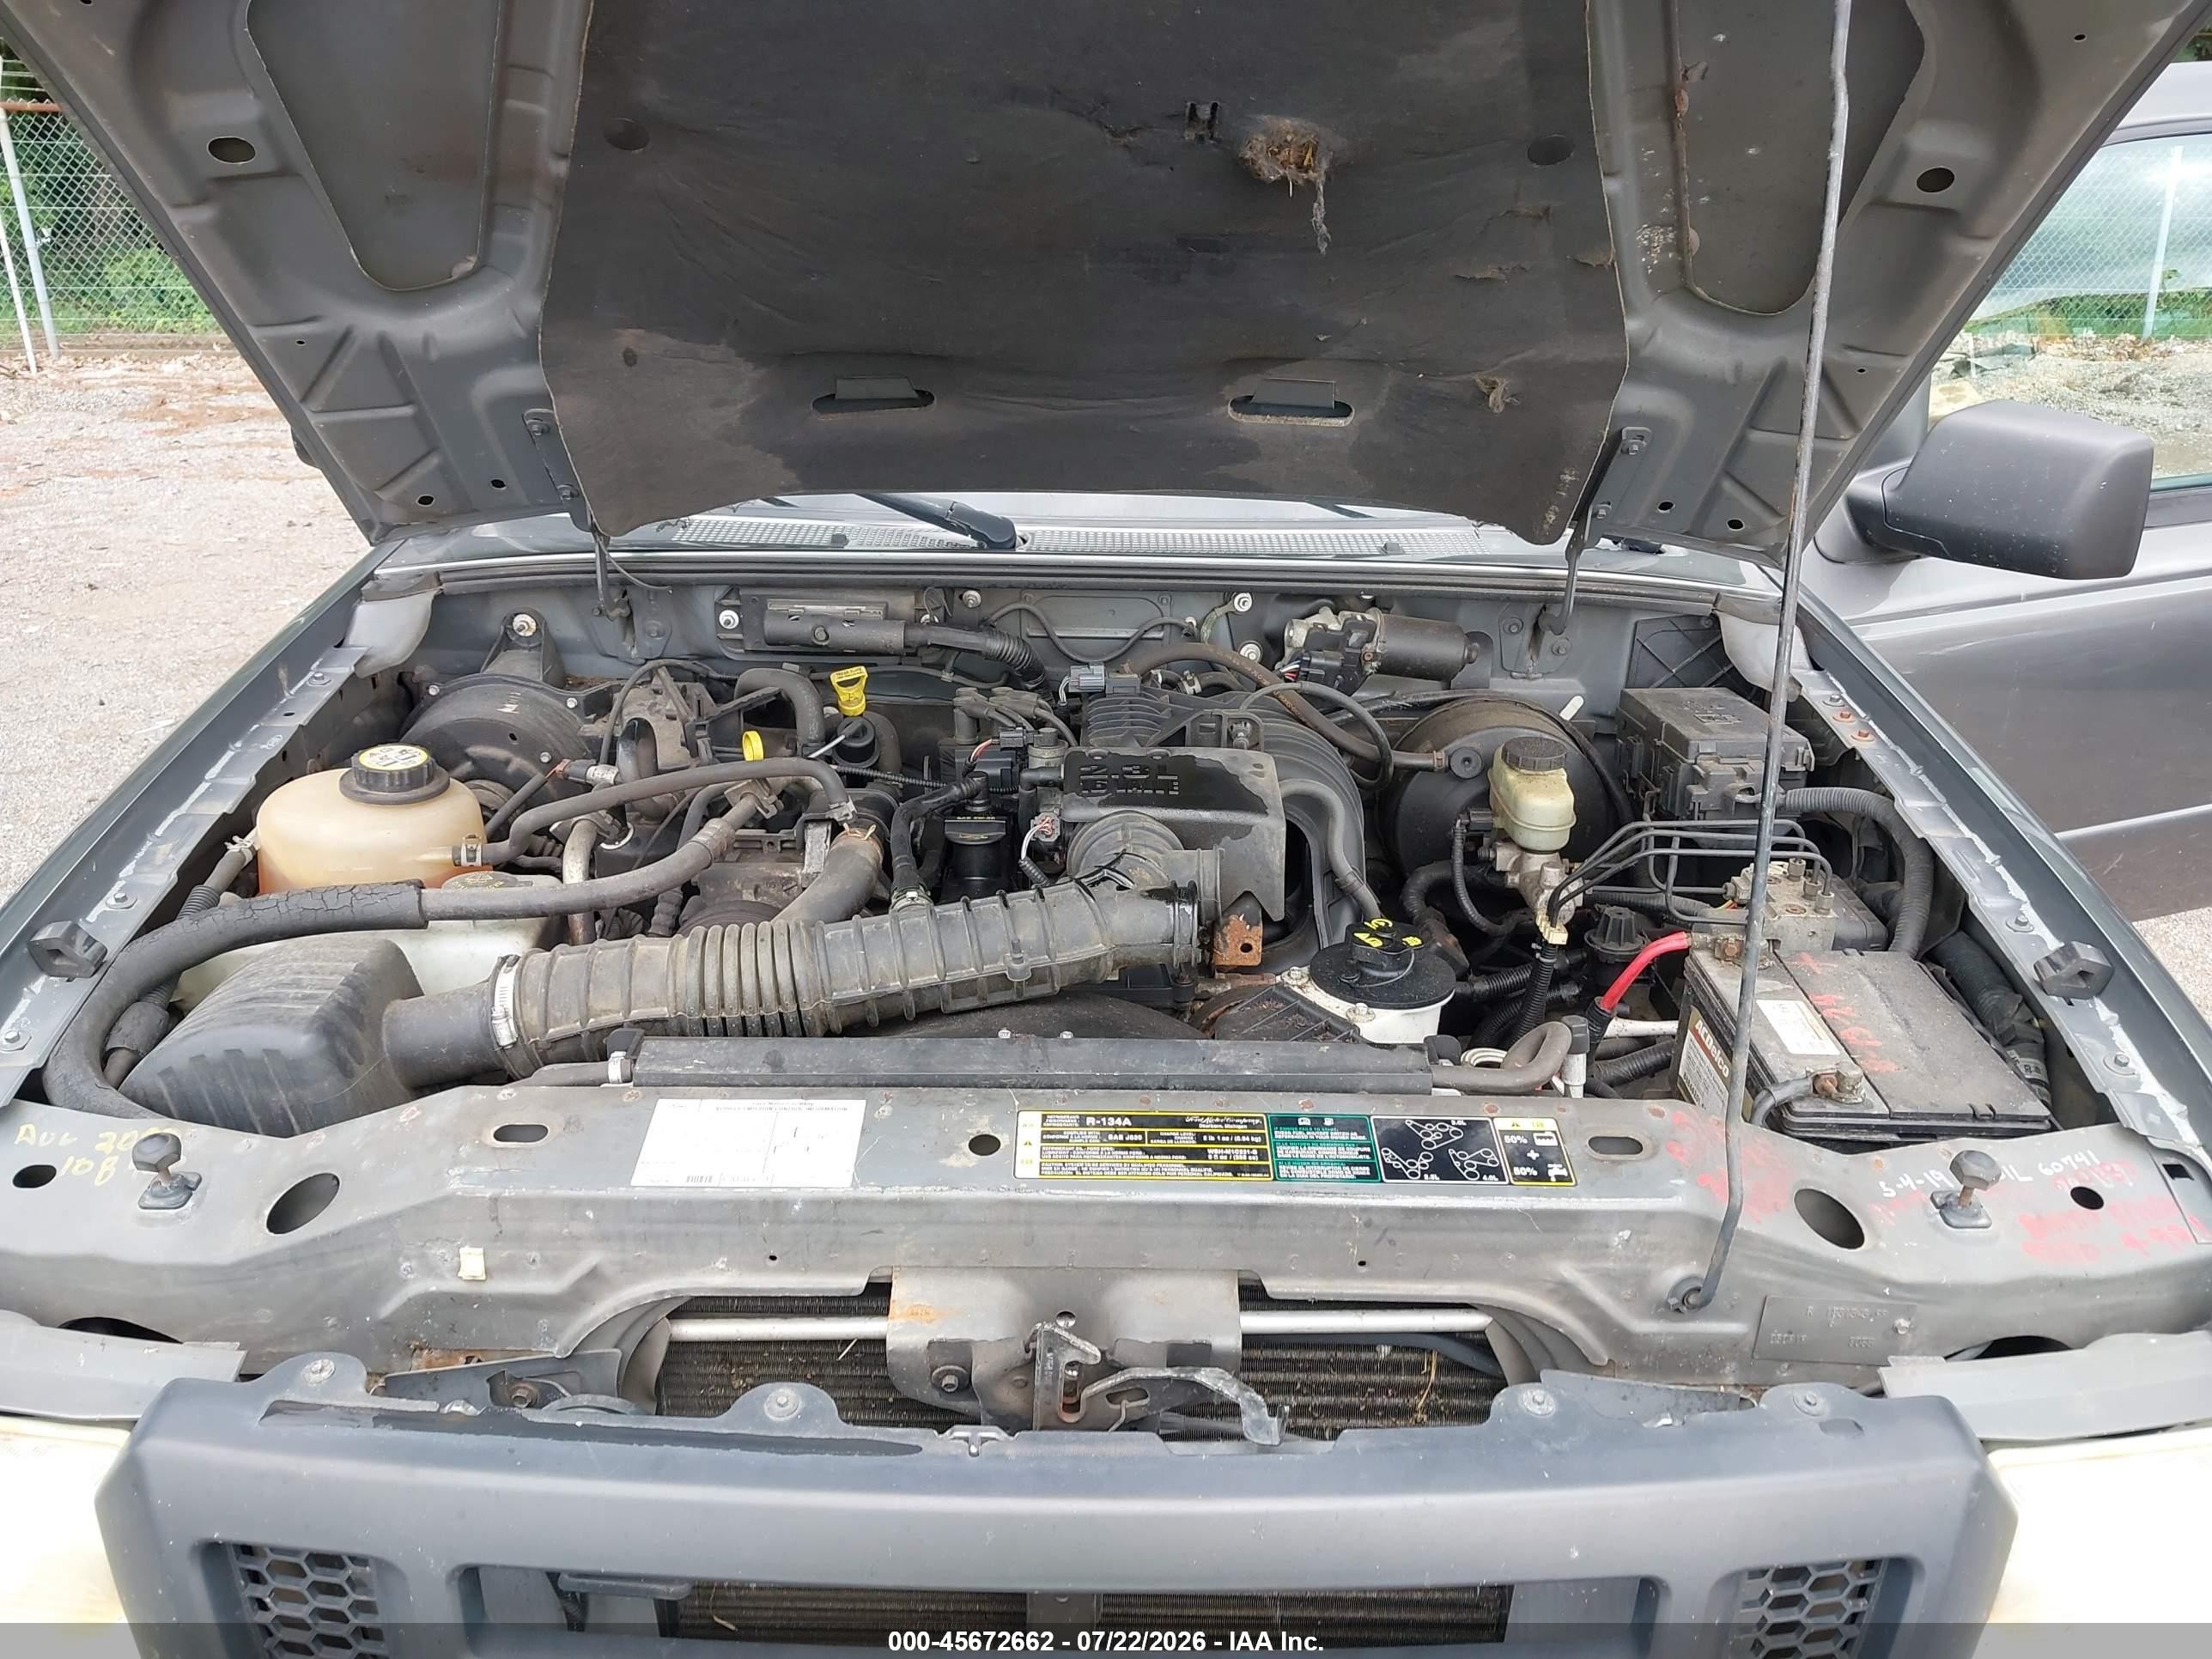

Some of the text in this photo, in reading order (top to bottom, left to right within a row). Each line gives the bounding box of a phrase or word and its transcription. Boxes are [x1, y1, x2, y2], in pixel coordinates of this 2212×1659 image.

[1695, 1019, 1729, 1078] ACDelco
[1086, 1117, 1132, 1127] R-134A
[1504, 1135, 1528, 1144] 50%
[1513, 1168, 1538, 1176] 50%
